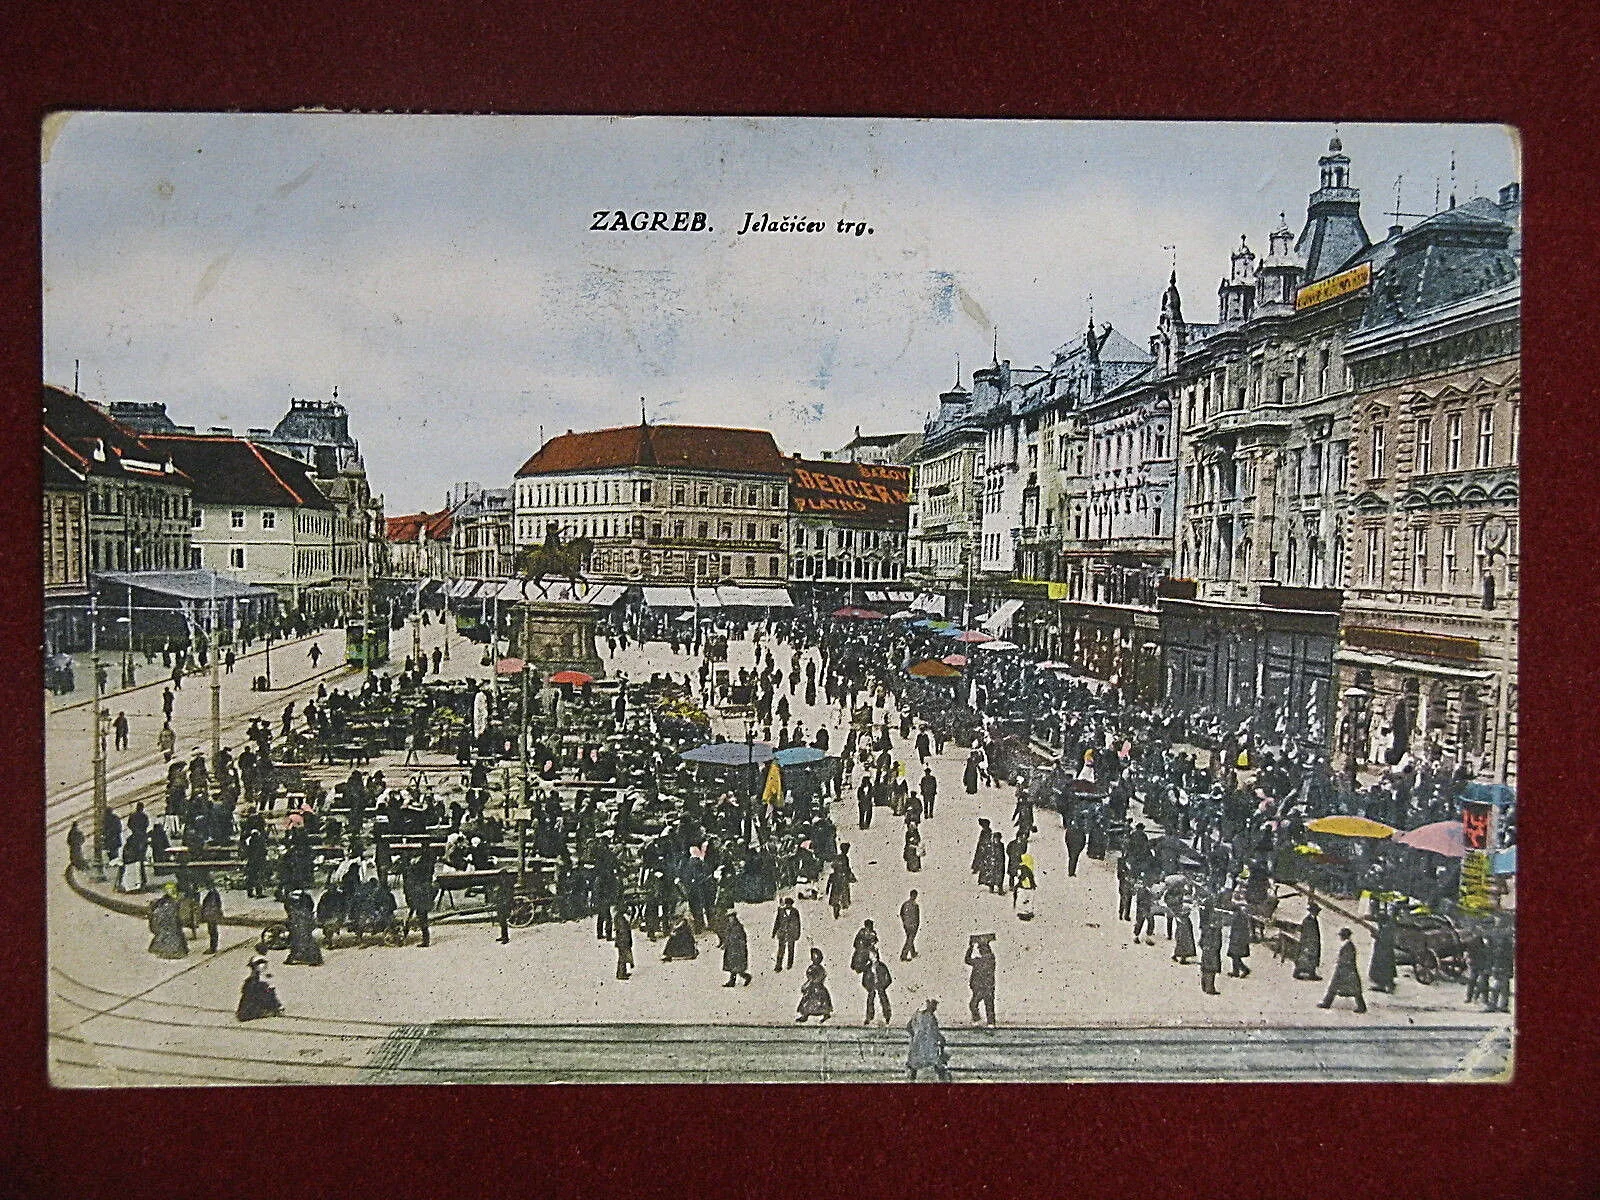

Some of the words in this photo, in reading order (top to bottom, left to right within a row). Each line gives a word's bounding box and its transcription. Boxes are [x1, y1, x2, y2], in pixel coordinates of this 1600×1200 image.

[589, 210, 714, 232] ZAGREB.
[737, 212, 826, 235] Jelačićev
[837, 218, 875, 237] trg.
